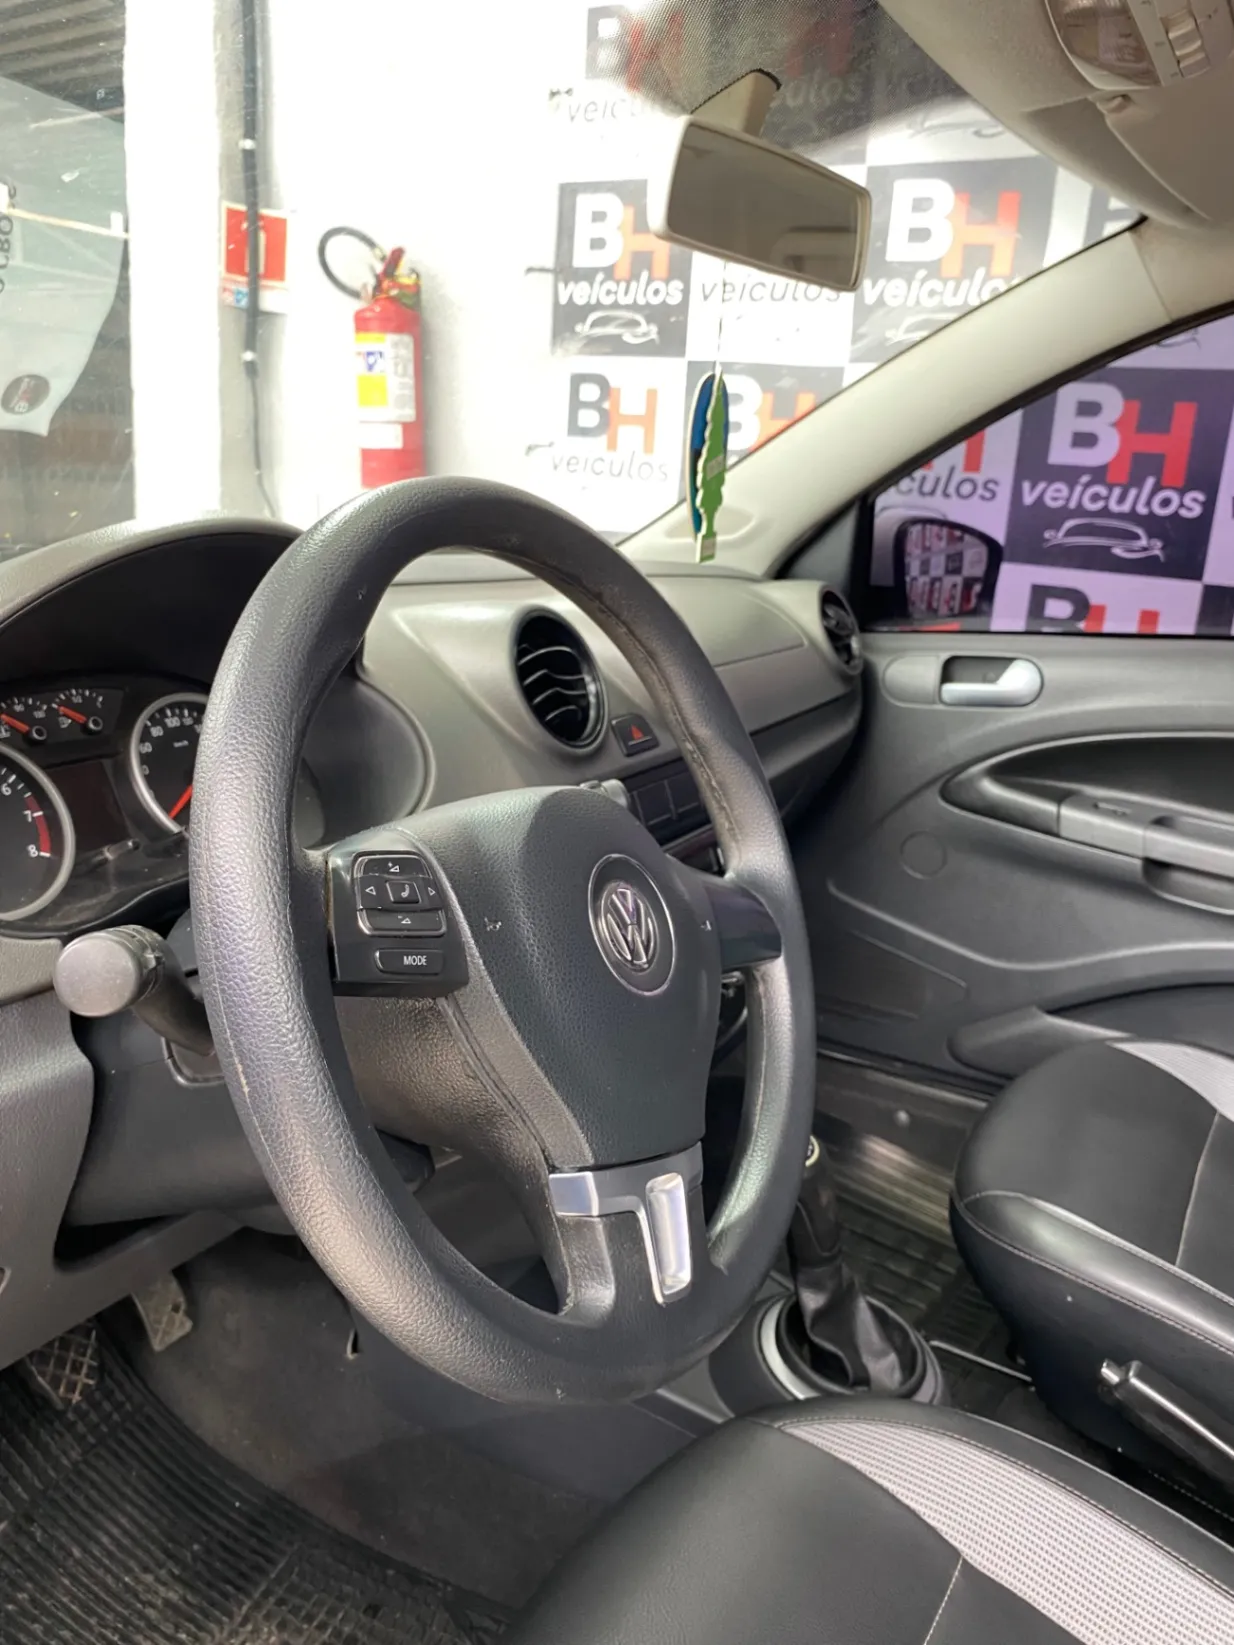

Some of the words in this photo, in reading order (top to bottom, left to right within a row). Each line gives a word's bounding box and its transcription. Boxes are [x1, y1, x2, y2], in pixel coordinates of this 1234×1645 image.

[572, 192, 672, 281] BH
[885, 178, 1022, 278] BH
[557, 270, 684, 305] veículos
[861, 267, 1023, 308] veículo
[567, 372, 658, 454] BH
[1047, 381, 1198, 489] BH
[896, 464, 1000, 502] culos
[1021, 474, 1206, 519] veículos
[1, 783, 12, 796] 6
[23, 810, 33, 823] 7
[27, 844, 39, 858] 8
[403, 955, 428, 966] MODE
